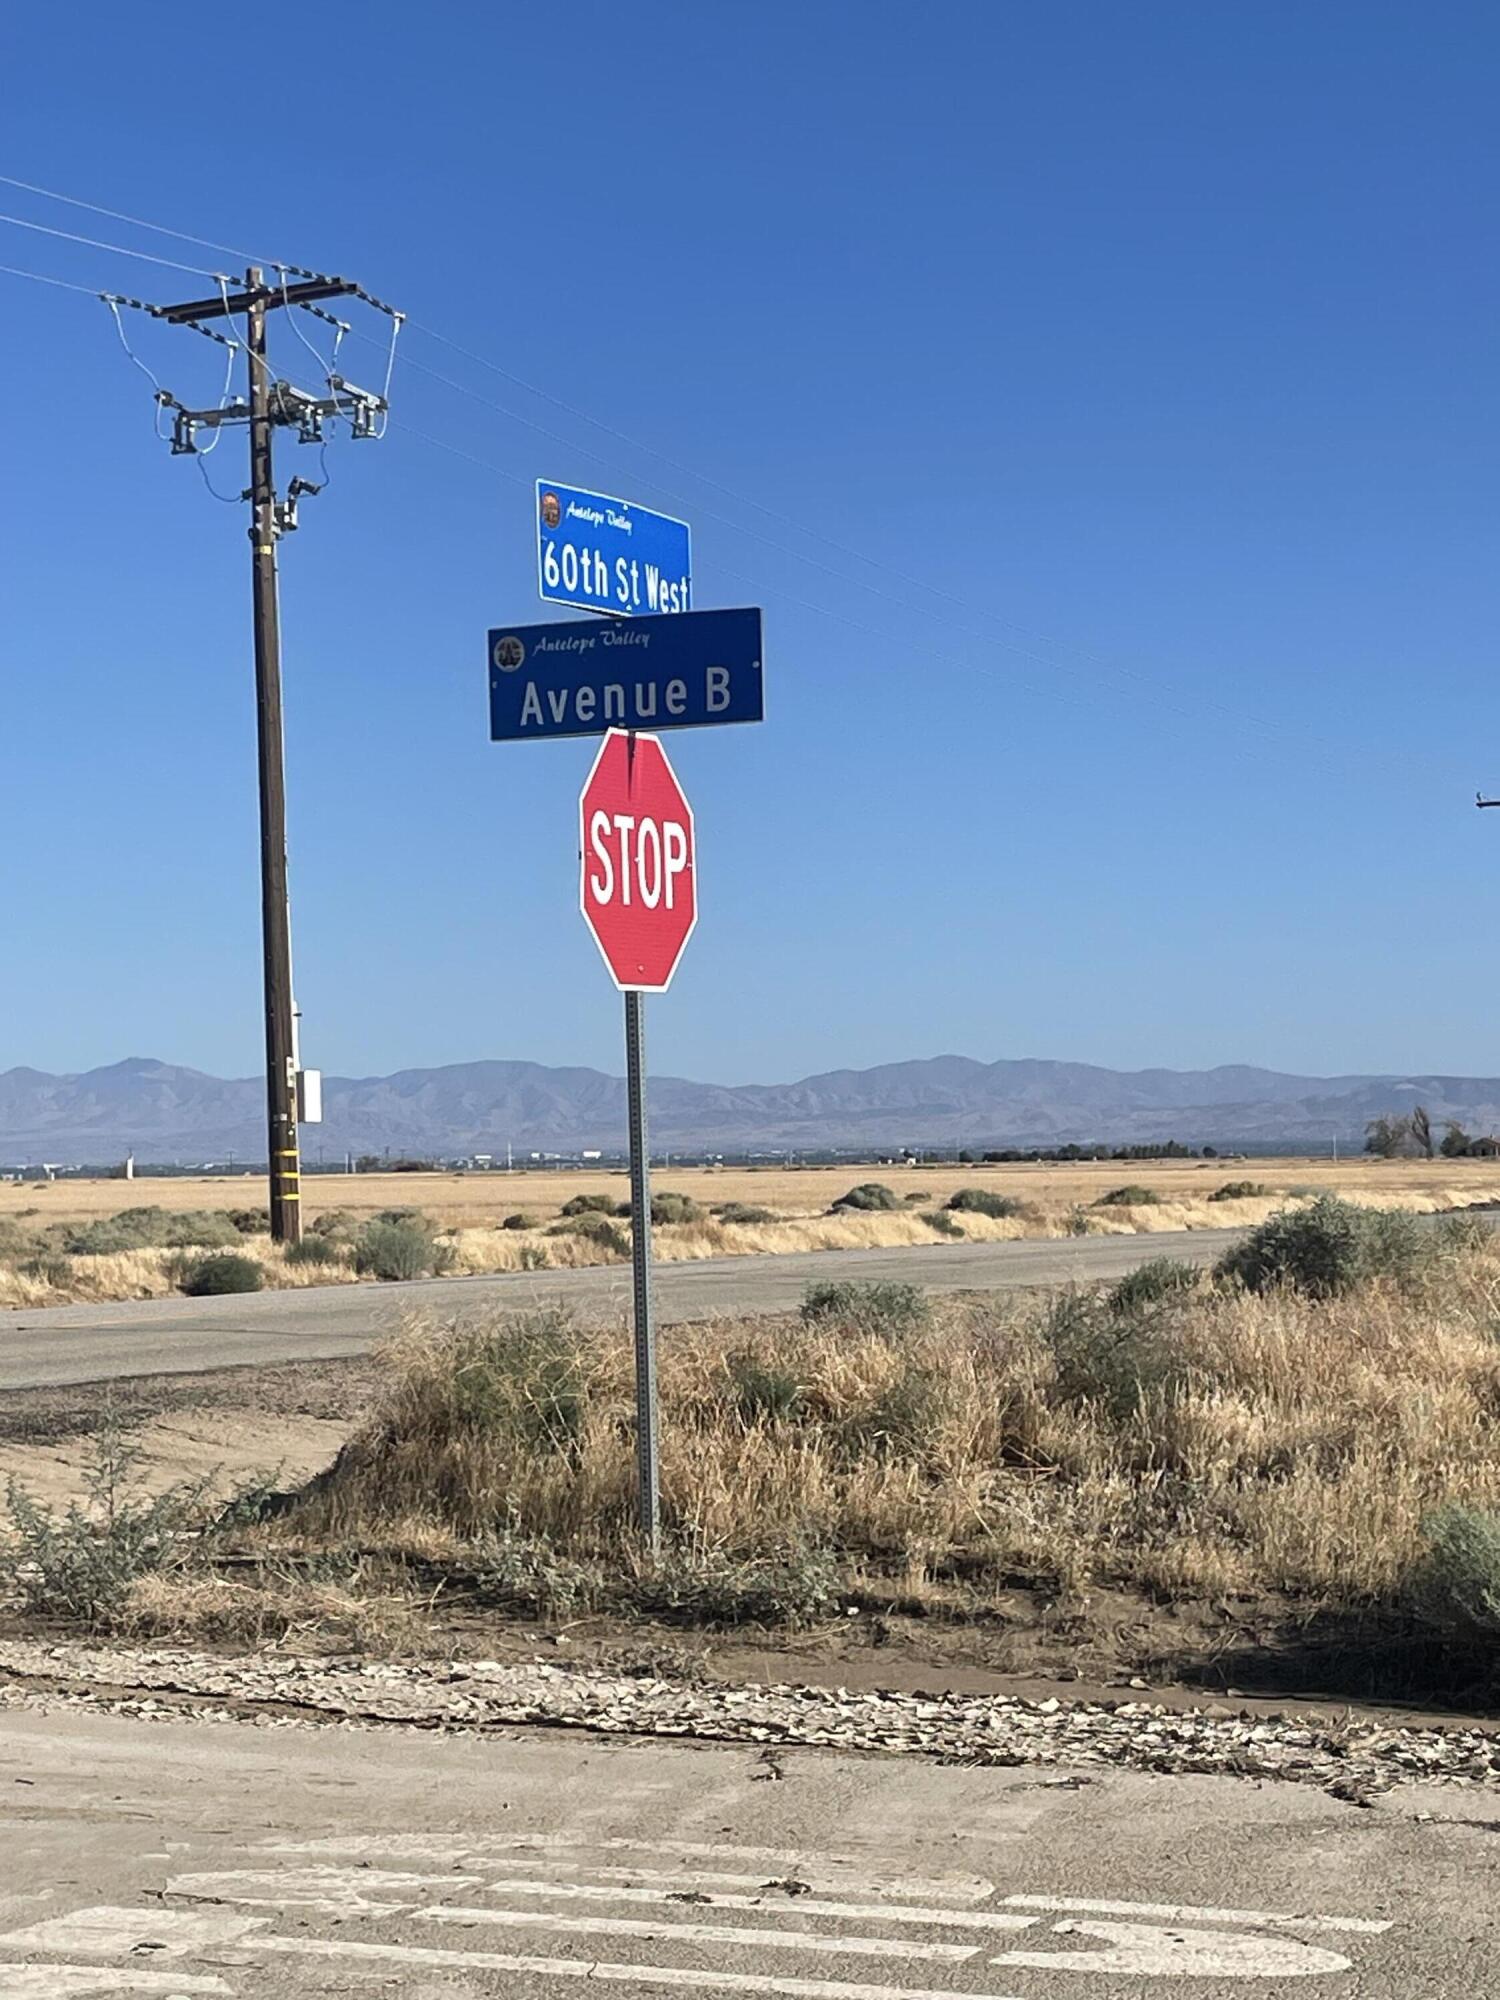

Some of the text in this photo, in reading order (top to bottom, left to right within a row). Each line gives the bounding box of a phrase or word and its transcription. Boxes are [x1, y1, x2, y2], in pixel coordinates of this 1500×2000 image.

[566, 500, 633, 536] Antelope Valley
[544, 541, 688, 613] 60th St West
[532, 630, 650, 656] Antelope Valley
[520, 666, 731, 726] Avenue B
[590, 810, 687, 909] STOP
